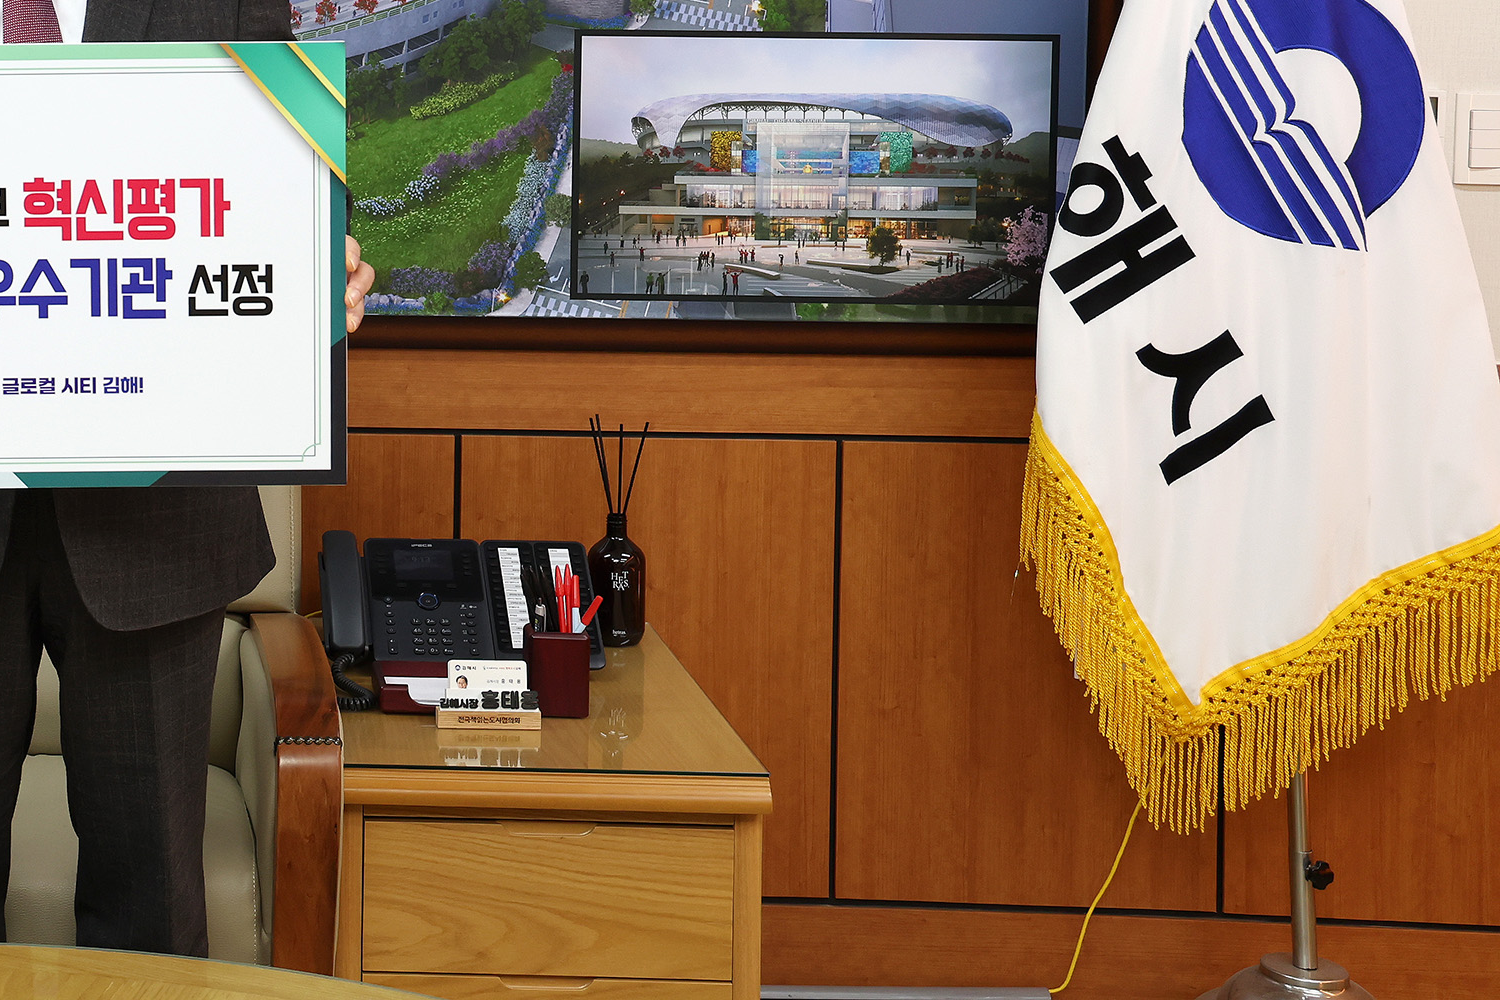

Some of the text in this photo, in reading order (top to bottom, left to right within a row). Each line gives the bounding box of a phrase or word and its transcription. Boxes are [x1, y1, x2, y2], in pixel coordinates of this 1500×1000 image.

[22, 177, 231, 242] 혁신평가
[187, 263, 274, 317] 선정
[2, 377, 56, 395] 글로컬
[61, 376, 97, 395] 시티
[102, 376, 144, 394] 김해!
